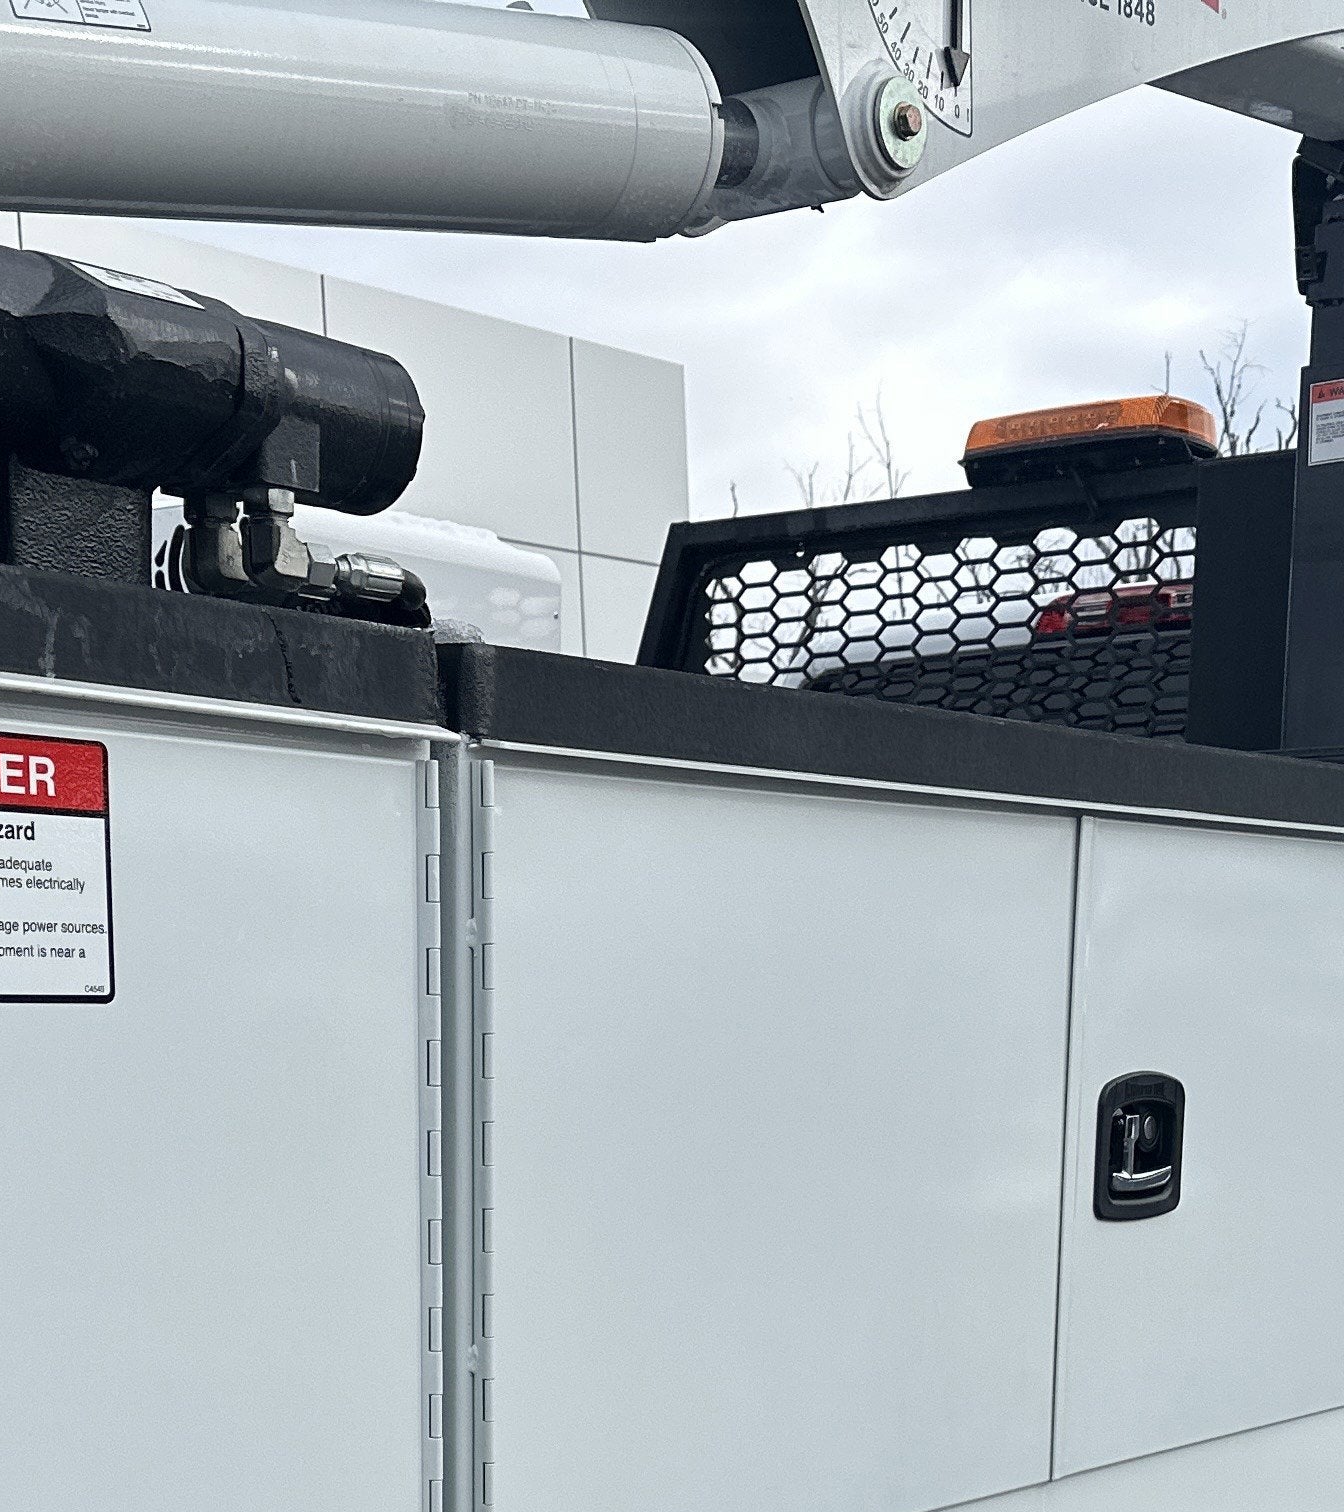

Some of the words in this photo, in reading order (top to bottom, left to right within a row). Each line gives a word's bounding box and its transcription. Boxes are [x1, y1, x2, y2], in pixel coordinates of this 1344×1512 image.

[1117, 0, 1155, 26] 1848
[877, 12, 889, 34] 50
[890, 41, 902, 61] 40
[903, 63, 915, 83] 30
[917, 81, 928, 99] 20
[934, 94, 945, 111] 10
[954, 104, 960, 119] 0
[26, 876, 85, 894] electrically
[23, 921, 57, 935] power
[61, 922, 107, 934] sources.
[38, 945, 47, 958] is
[50, 946, 76, 958] near
[79, 948, 86, 958] a
